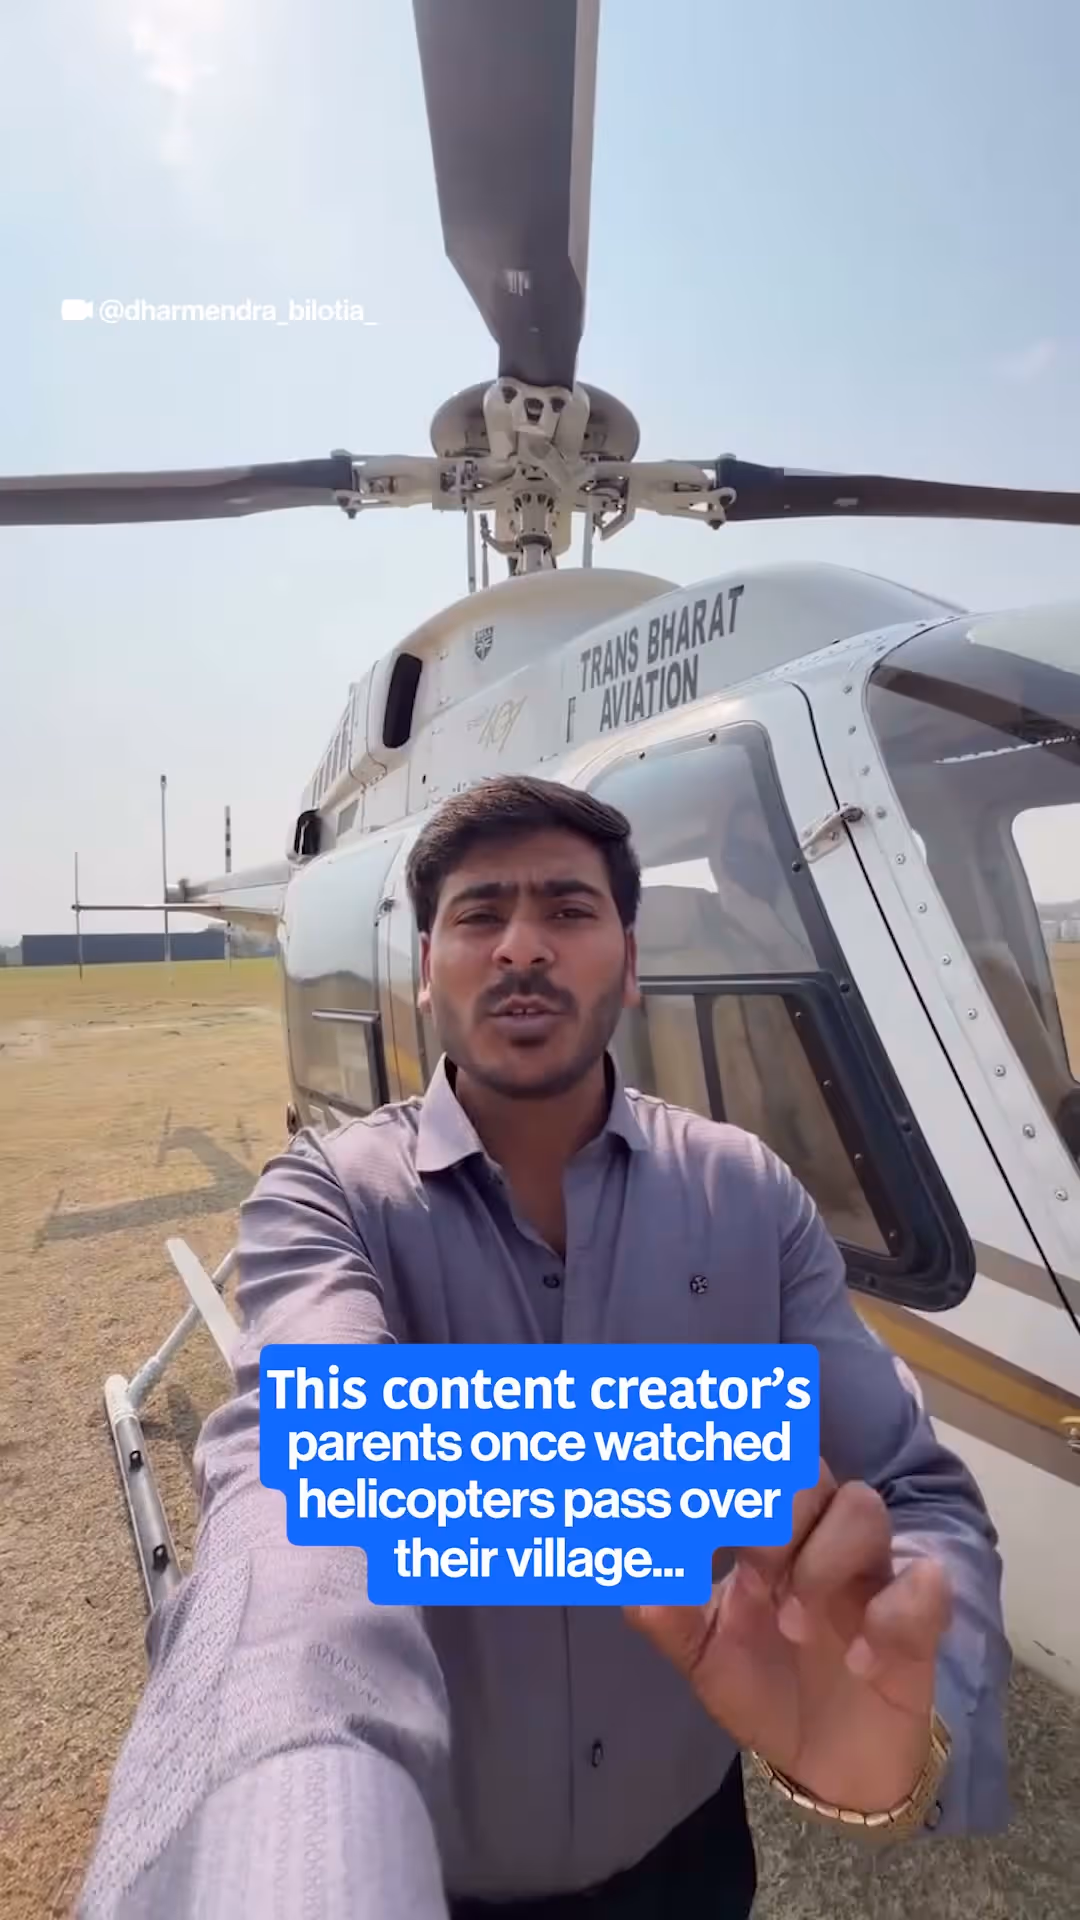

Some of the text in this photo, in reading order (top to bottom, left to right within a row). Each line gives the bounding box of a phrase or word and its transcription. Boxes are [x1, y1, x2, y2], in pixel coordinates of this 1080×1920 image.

[580, 584, 745, 692] TRANS BHARAT
[600, 653, 699, 733] AVIATION
